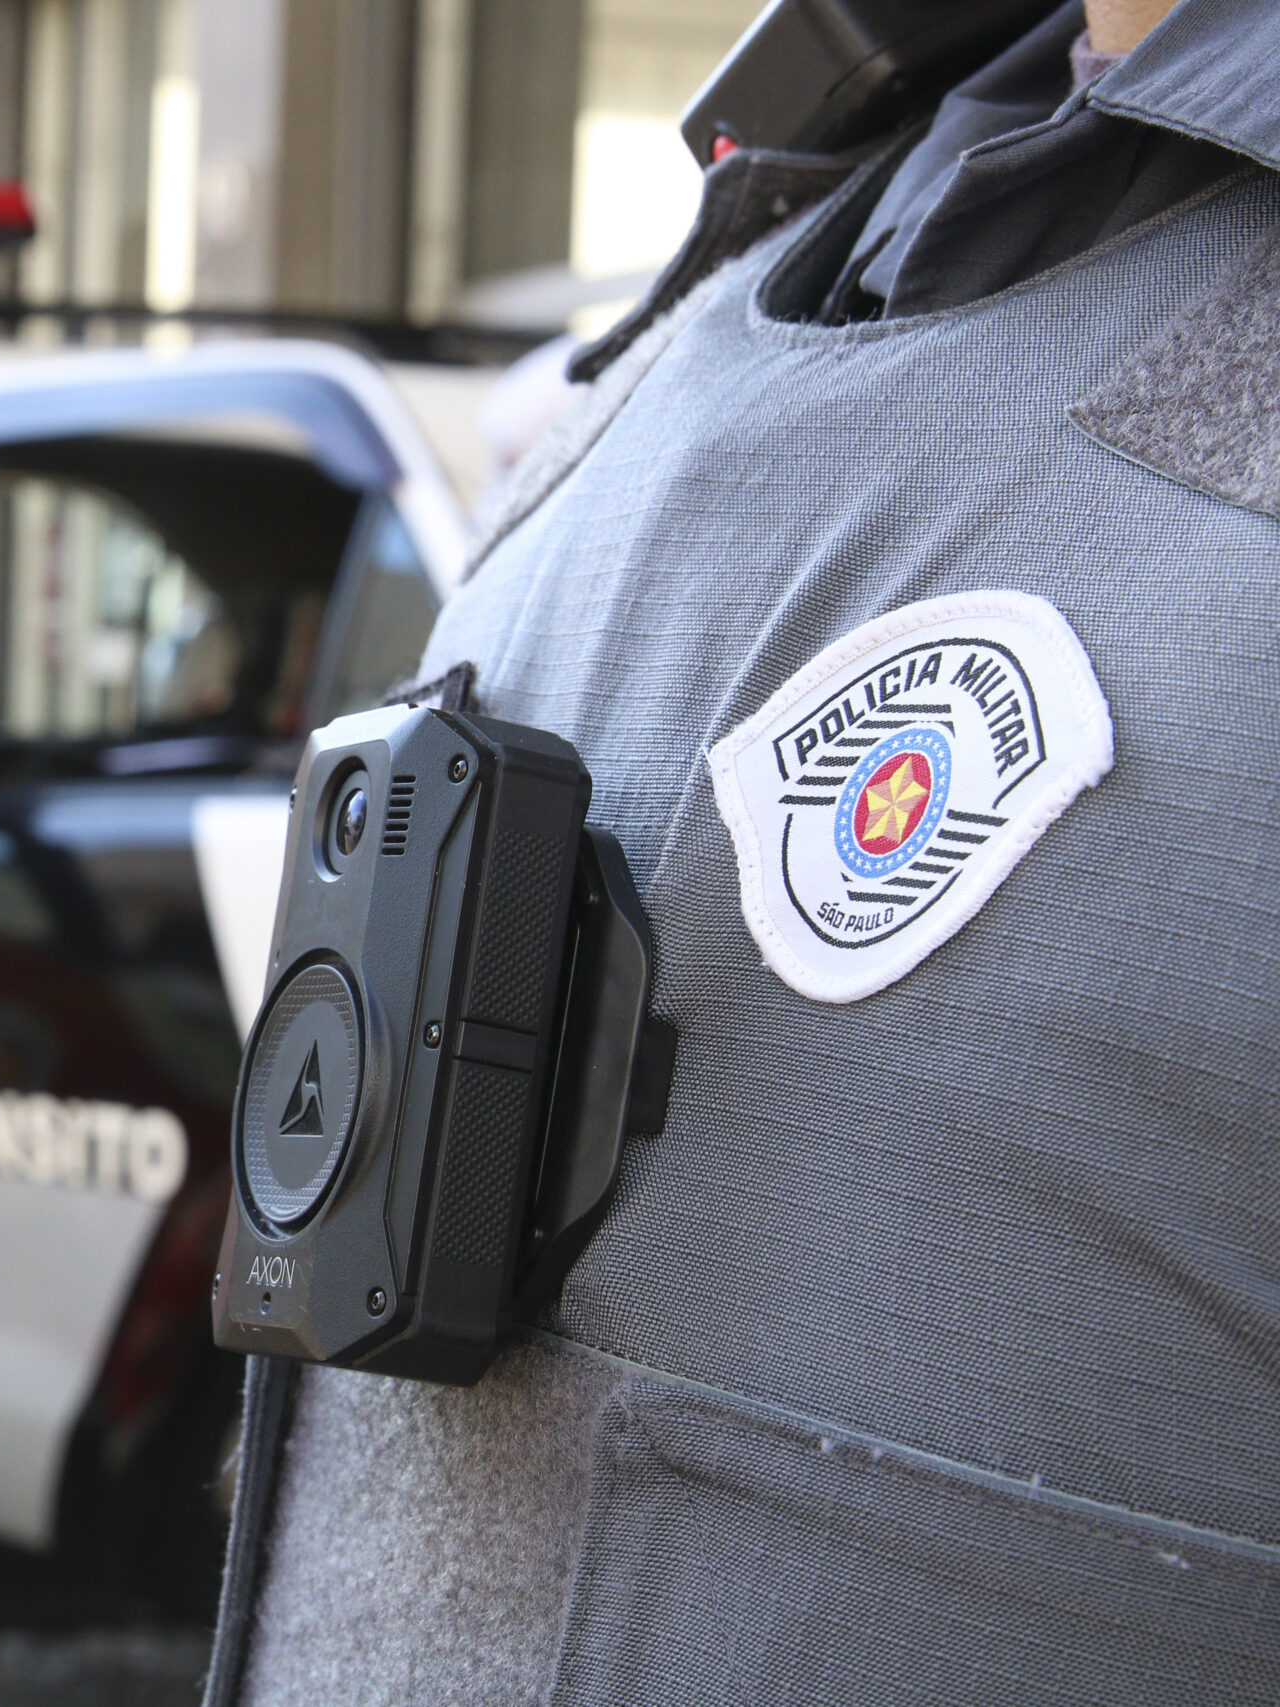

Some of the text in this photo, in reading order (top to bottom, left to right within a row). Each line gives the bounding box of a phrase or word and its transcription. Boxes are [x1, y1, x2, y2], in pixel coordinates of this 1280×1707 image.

[949, 653, 1030, 779] MILITAR
[817, 902, 894, 932] SÃO PAULO
[247, 1255, 296, 1287] AXON
